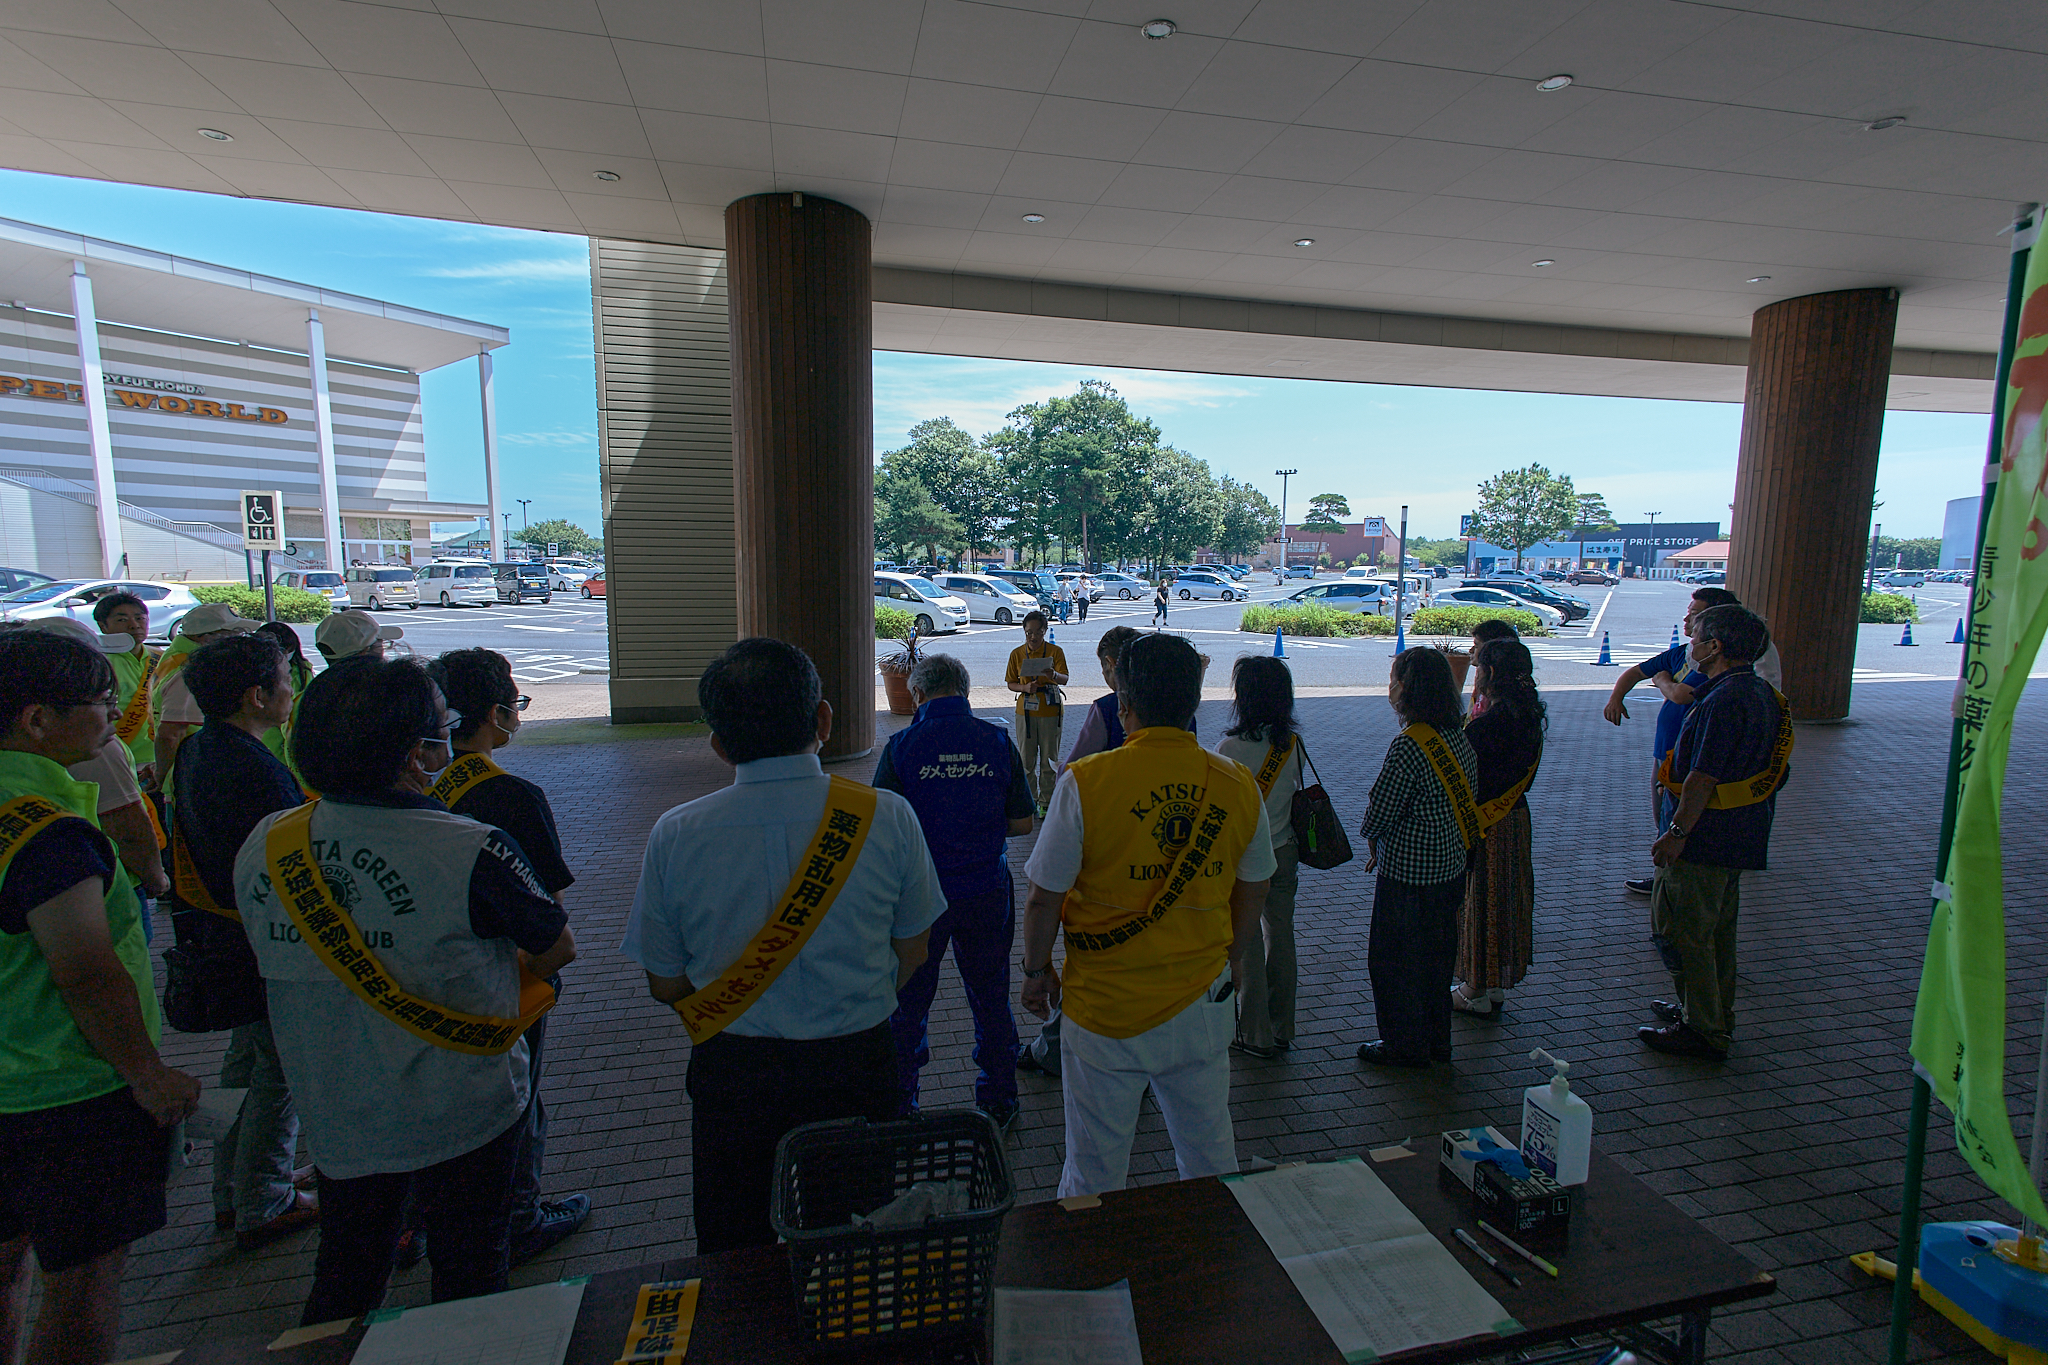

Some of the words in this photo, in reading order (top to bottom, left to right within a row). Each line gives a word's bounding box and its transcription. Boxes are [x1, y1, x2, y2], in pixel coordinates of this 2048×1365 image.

[102, 374, 151, 389] OYFUL
[114, 390, 289, 424] WORLD
[1629, 538, 1661, 546] PRICE
[1663, 538, 1699, 546] STORE
[939, 754, 974, 763] 薬物乱用は
[919, 763, 994, 780] ダメ。ゼッタイ。
[1130, 783, 1206, 822] KATSU
[1162, 804, 1196, 817] LIONS
[1129, 863, 1175, 881] LION
[351, 848, 416, 916] GREEN
[1526, 1122, 1556, 1160] 75%
